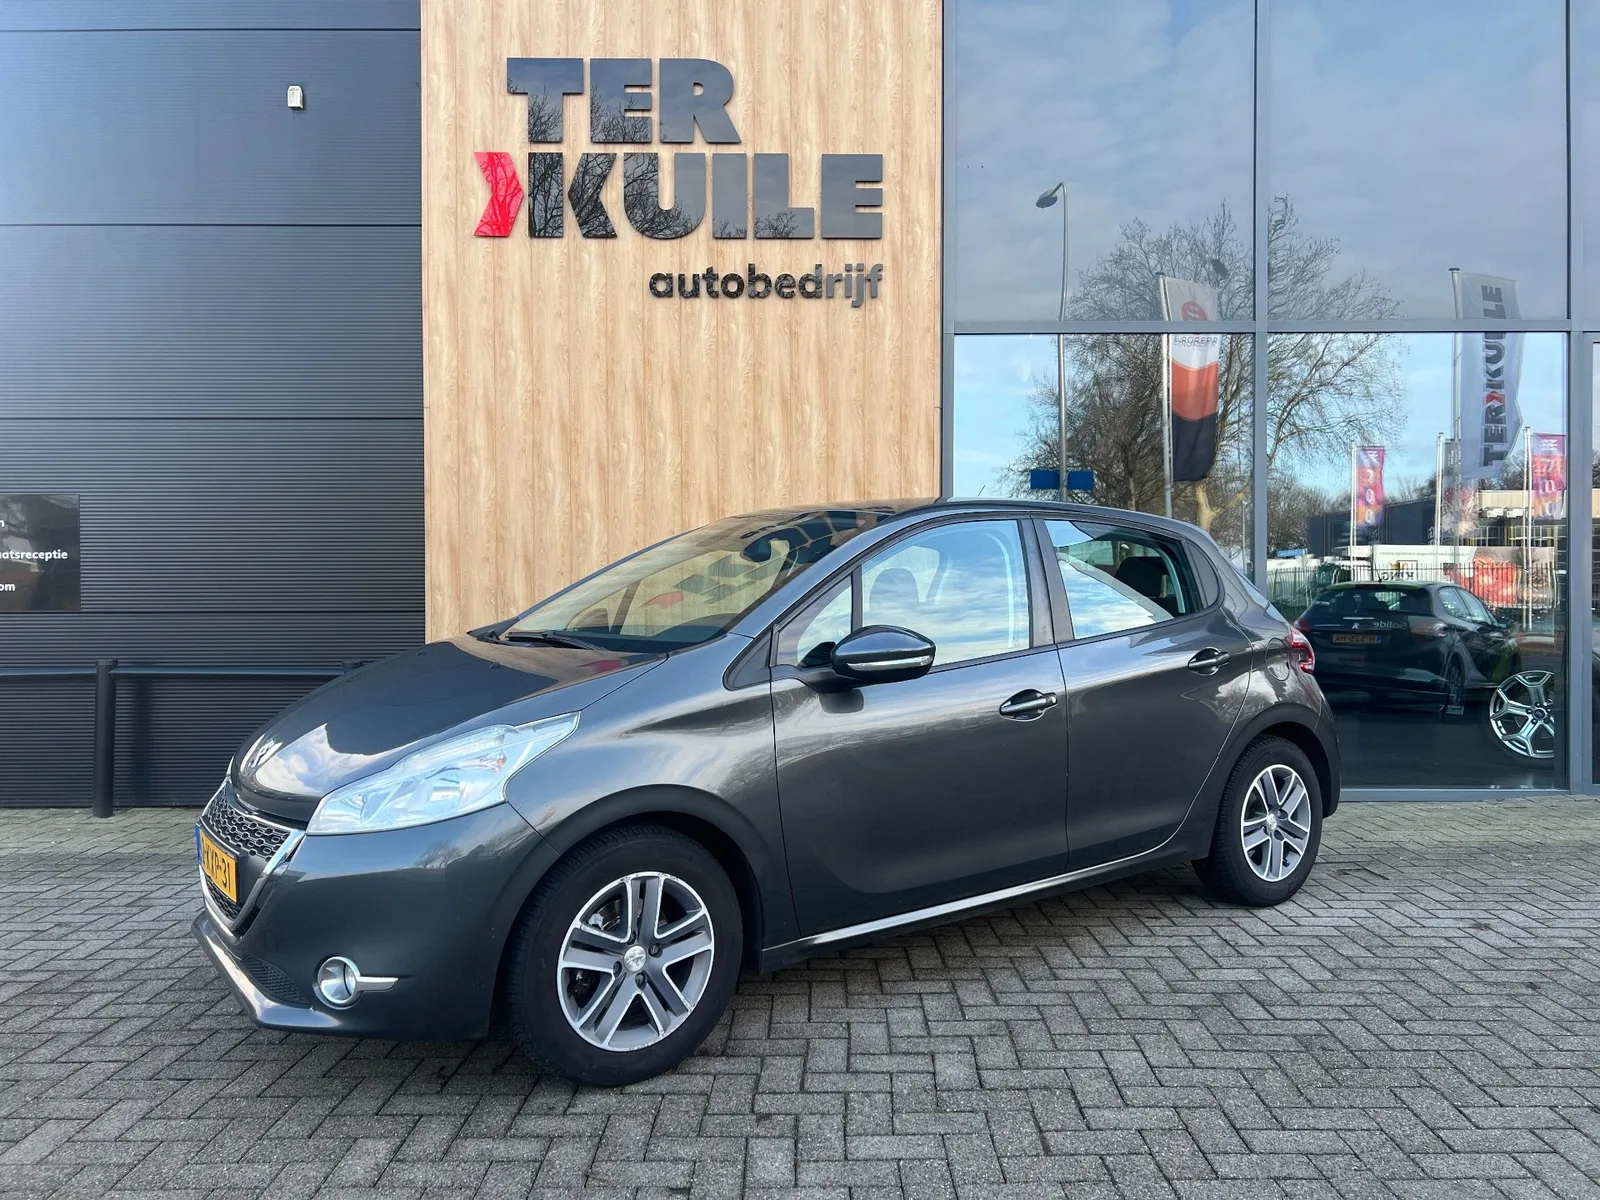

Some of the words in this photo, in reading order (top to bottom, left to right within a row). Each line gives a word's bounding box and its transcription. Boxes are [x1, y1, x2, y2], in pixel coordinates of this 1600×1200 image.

[507, 57, 742, 144] TER
[528, 153, 884, 240] KUILE
[649, 263, 884, 307] autobedrijf
[1483, 404, 1508, 467] TER
[0, 549, 68, 561] atsreceptie
